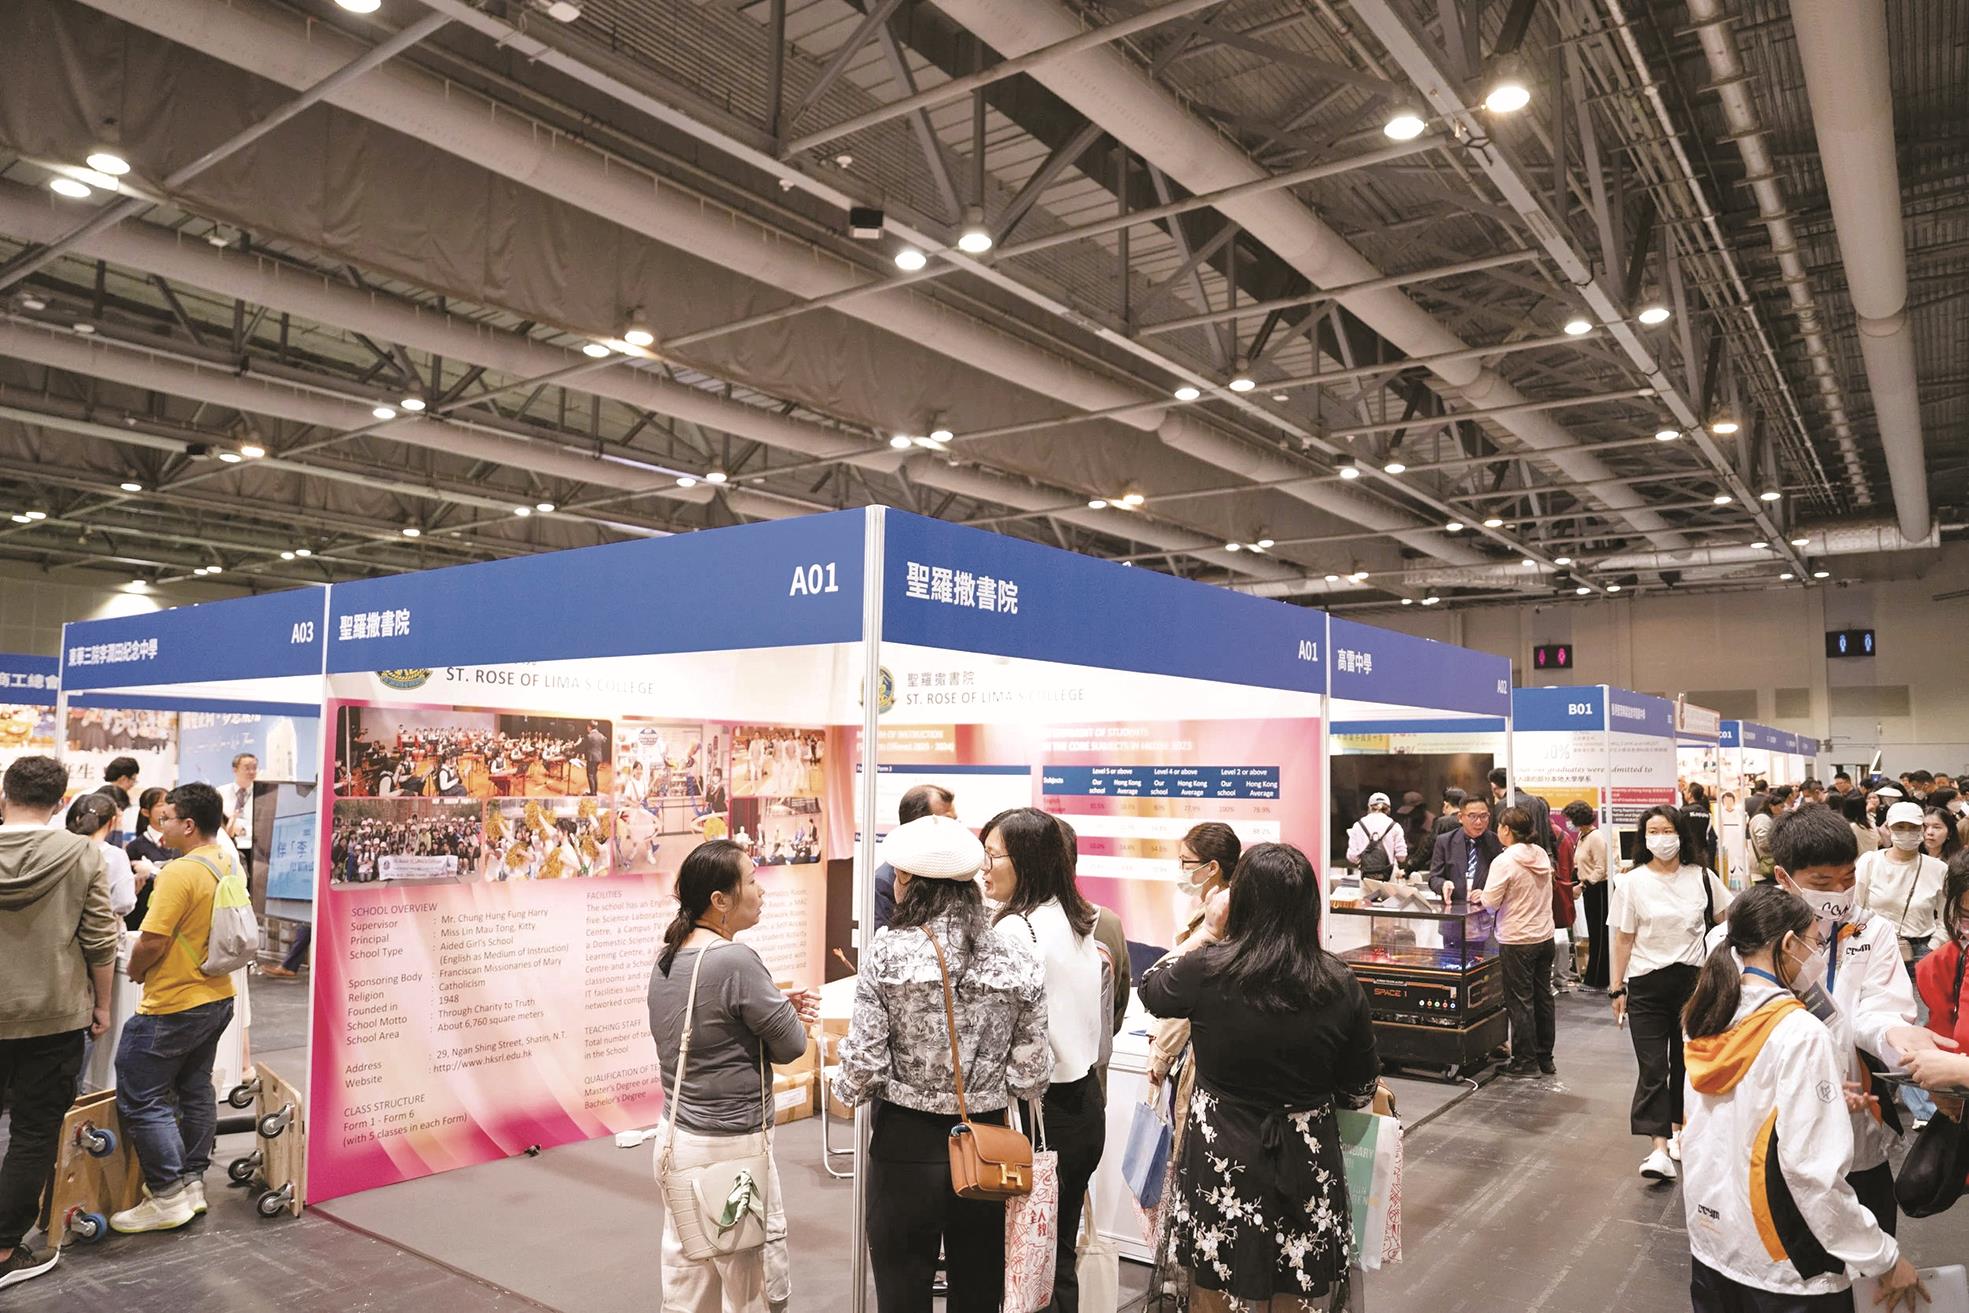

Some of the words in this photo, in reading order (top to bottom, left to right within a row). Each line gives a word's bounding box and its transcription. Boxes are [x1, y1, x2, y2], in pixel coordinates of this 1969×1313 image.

[790, 562, 838, 596] A01
[906, 560, 1018, 615] 聖羅撒書院
[339, 608, 410, 641] 聖羅撒書院
[291, 621, 313, 644] A03
[1299, 640, 1318, 662] A01
[1337, 648, 1372, 674] 高雷中學
[446, 666, 469, 682] ST.
[476, 669, 514, 686] ROSE
[520, 673, 539, 687] OF
[1497, 680, 1508, 694] A02
[906, 694, 923, 705] ST.
[927, 693, 957, 705] ROSE
[961, 692, 976, 704] OF
[1568, 703, 1592, 715] B01
[1154, 768, 1168, 776] Level
[1221, 768, 1236, 776] Level
[1177, 780, 1192, 788] Hong
[1193, 781, 1208, 789] Kong
[1220, 780, 1233, 788] Our
[1246, 781, 1262, 789] Hong
[1262, 781, 1278, 789] Kong
[1151, 788, 1168, 796] school
[1181, 789, 1204, 797] Average
[1217, 789, 1236, 797] school
[1249, 790, 1274, 798] Average
[351, 906, 388, 917] SCHOOL
[390, 903, 438, 914] OVERVIEW
[441, 915, 456, 924] Mr.
[458, 913, 483, 923] Chung
[485, 912, 506, 921] Hung
[507, 910, 526, 920] Fung
[527, 908, 549, 918] Harry
[351, 920, 398, 932] Supervisor
[441, 928, 460, 937] Miss
[462, 927, 474, 936] Lin
[475, 926, 494, 934] Mau
[518, 922, 536, 931] Kitty
[350, 933, 389, 945] Principal
[440, 941, 464, 951] Aided
[488, 936, 514, 946] School
[349, 948, 379, 960] School
[382, 947, 403, 957] Type
[440, 953, 471, 966] (English
[484, 950, 516, 960] Medium
[527, 943, 569, 956] Instruction)
[439, 966, 482, 978] Franciscan
[484, 961, 531, 973] Missionaries
[543, 957, 562, 967] Mary
[348, 976, 399, 989] Sponsoring
[401, 971, 423, 982] Body
[438, 979, 486, 991] Catholicism
[348, 991, 384, 1002] Religion
[439, 994, 459, 1005] 1948
[1374, 988, 1401, 998] SPACE
[347, 1003, 388, 1016] Founded
[438, 1007, 472, 1018] Through
[515, 998, 536, 1008] Truth
[347, 1019, 377, 1031] School
[380, 1016, 408, 1026] Motto
[437, 1021, 463, 1032] About
[464, 1017, 488, 1028] 6,760
[489, 1013, 516, 1025] square
[517, 1009, 545, 1020] meters
[584, 1023, 620, 1035] TEACHING
[622, 1018, 641, 1029] STAFF
[346, 1033, 377, 1046] School
[379, 1031, 400, 1040] Area
[585, 1037, 602, 1048] Total
[604, 1033, 630, 1044] number
[436, 1049, 450, 1060] 29,
[451, 1046, 473, 1058] Ngan
[475, 1041, 497, 1053] Shing
[593, 1050, 605, 1058] the
[606, 1044, 629, 1056] School
[345, 1061, 382, 1074] Address
[345, 1075, 383, 1088] Website
[584, 1067, 638, 1084] QUALIFICATION
[584, 1084, 615, 1096] Master's
[616, 1080, 641, 1091] Degree
[343, 1104, 372, 1117] CLASS
[373, 1094, 425, 1112] STRUCTURE
[584, 1095, 620, 1110] Bachelor's
[622, 1091, 646, 1102] Degree
[343, 1119, 368, 1131] Form
[383, 1112, 407, 1123] Form
[343, 1135, 367, 1148] (with
[377, 1126, 408, 1139] classes
[420, 1118, 440, 1129] each
[442, 1112, 468, 1125] Form)
